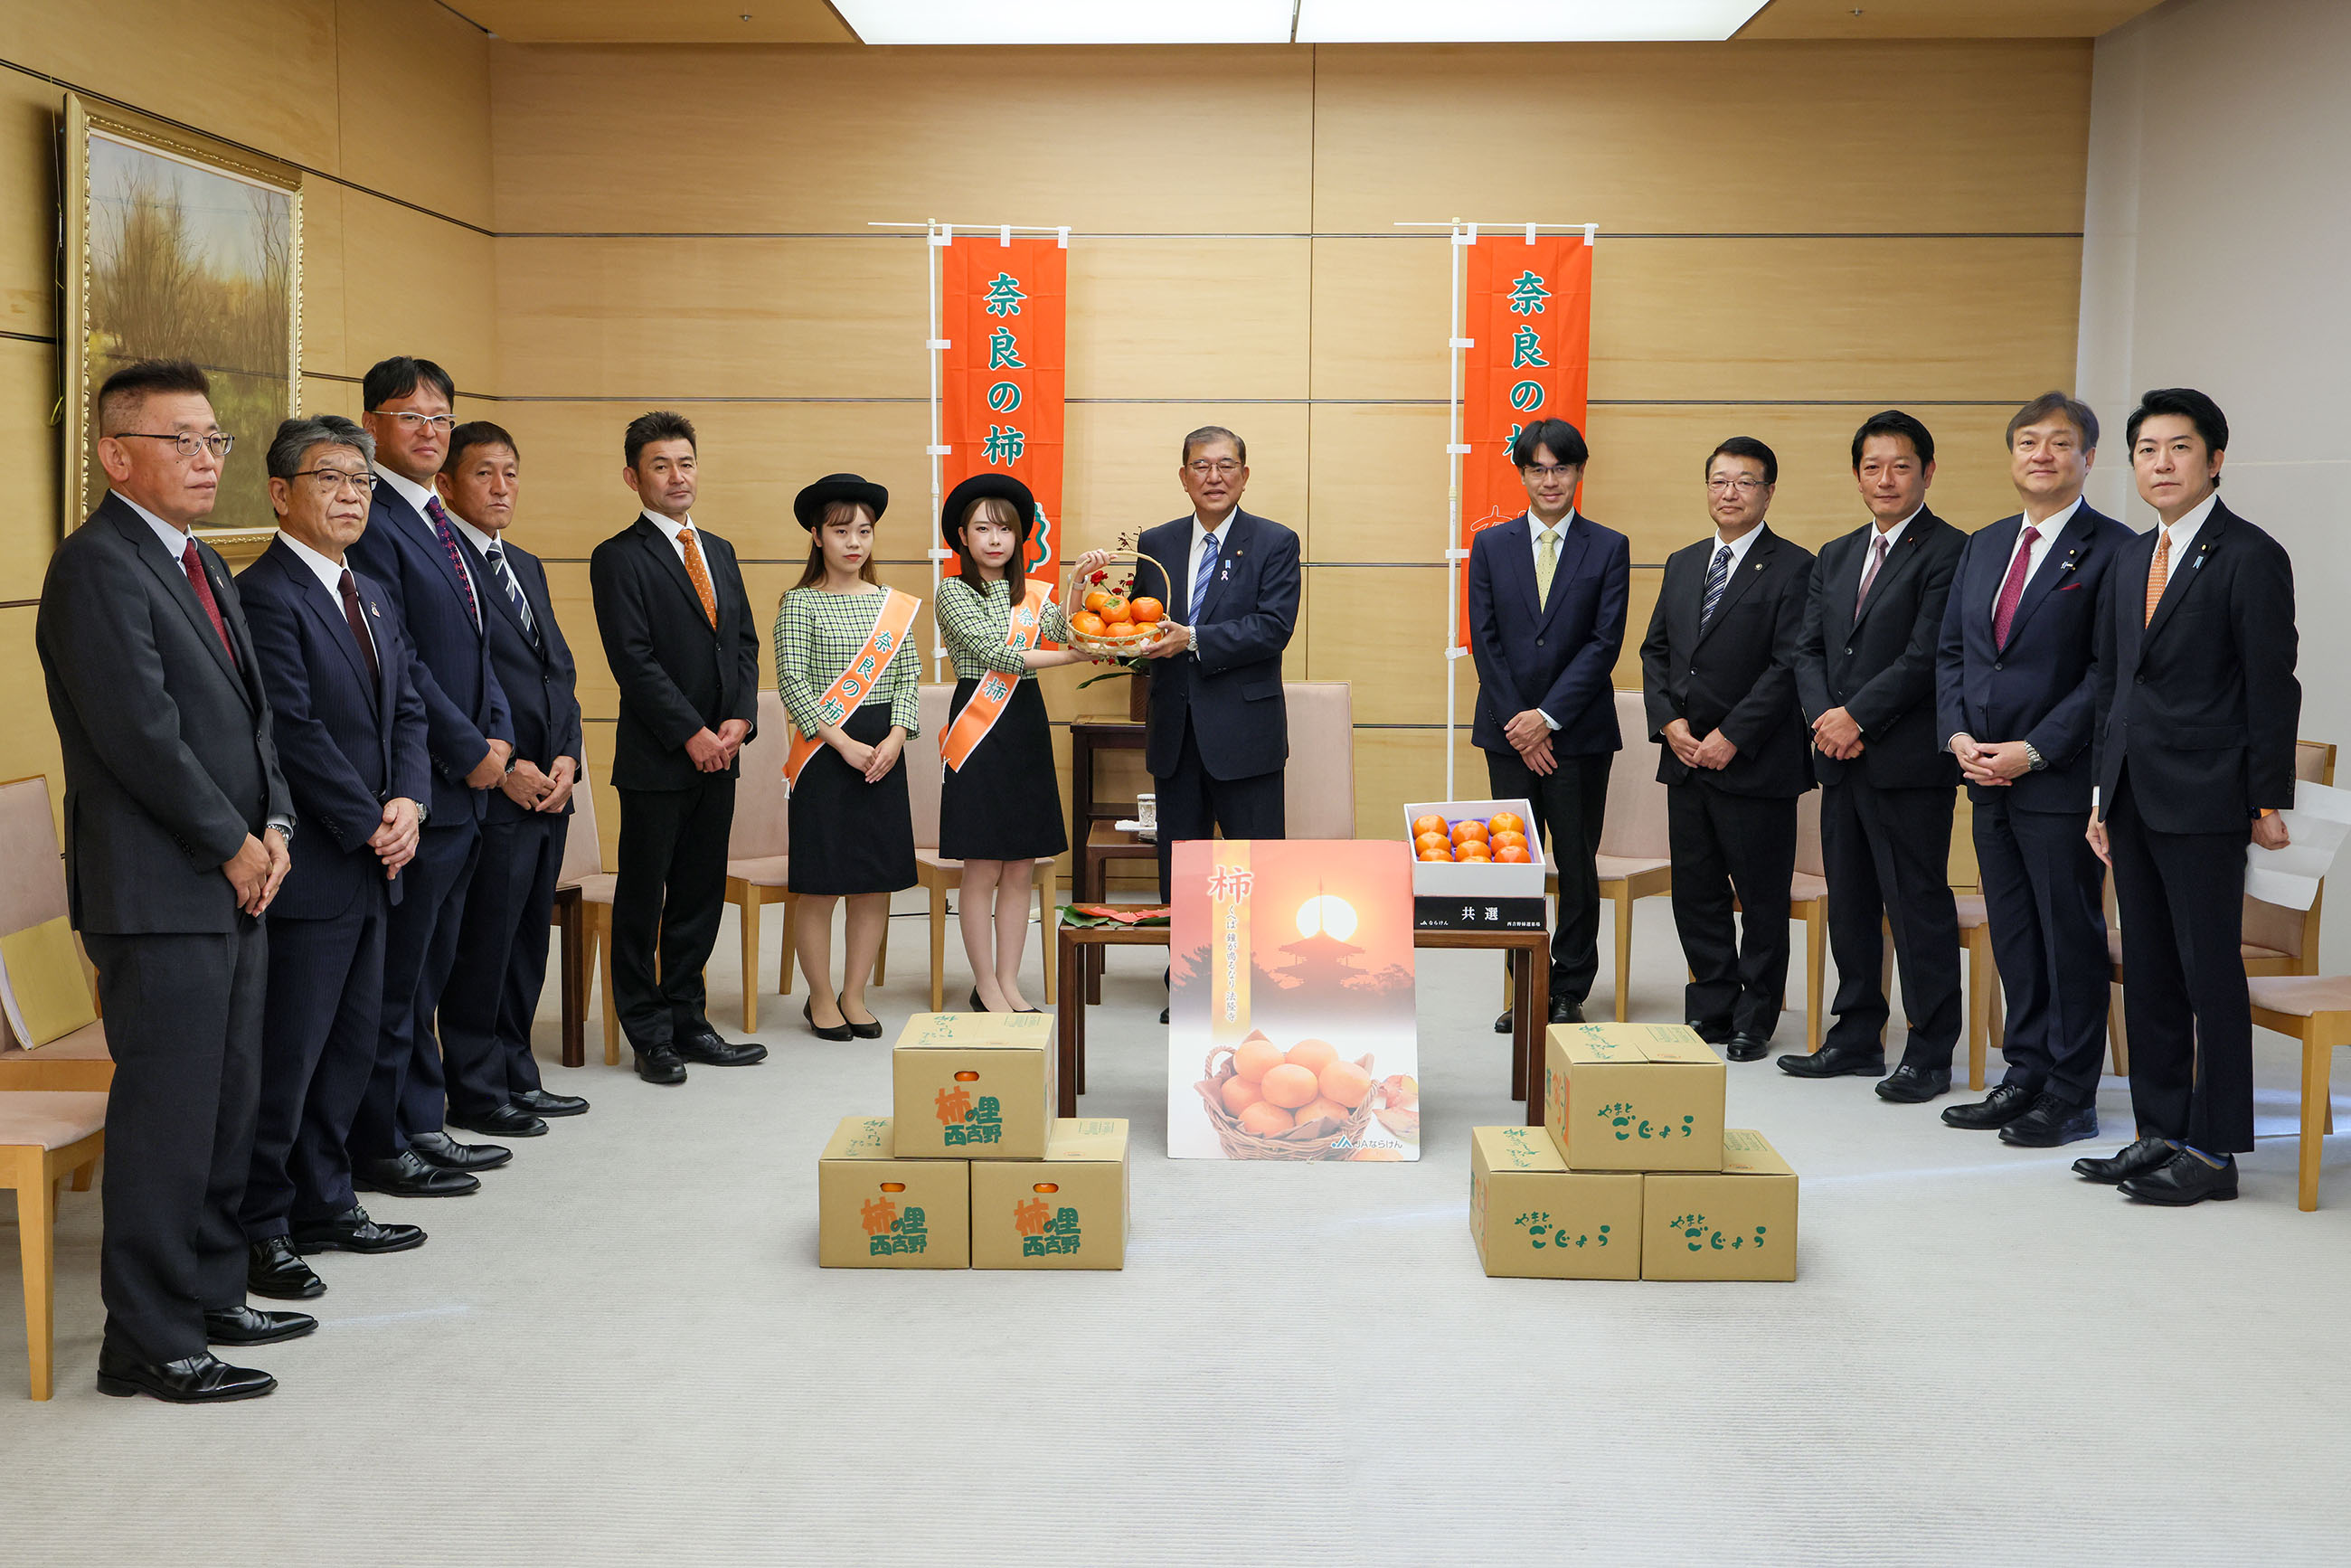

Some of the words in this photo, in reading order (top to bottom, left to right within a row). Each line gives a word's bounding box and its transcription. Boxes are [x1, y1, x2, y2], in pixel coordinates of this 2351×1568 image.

[982, 273, 1027, 467] 奈良の柿
[824, 630, 893, 722] 奈良の柿
[1206, 865, 1253, 903] 柿
[1461, 906, 1499, 921] 共選
[935, 1086, 1002, 1125] 柿の里
[1598, 1102, 1633, 1118] やまと
[944, 1124, 1002, 1147] 西吉野
[1612, 1115, 1694, 1140] ごじょう
[861, 1196, 928, 1236] 柿の里
[1014, 1197, 1081, 1236] 柿の里
[1515, 1212, 1550, 1226] やまと
[1670, 1214, 1705, 1229] やまと
[870, 1234, 928, 1256] 西吉野
[1023, 1235, 1081, 1257] 西吉野
[1529, 1223, 1610, 1249] ごじょう
[1685, 1226, 1766, 1252] ごじょう
